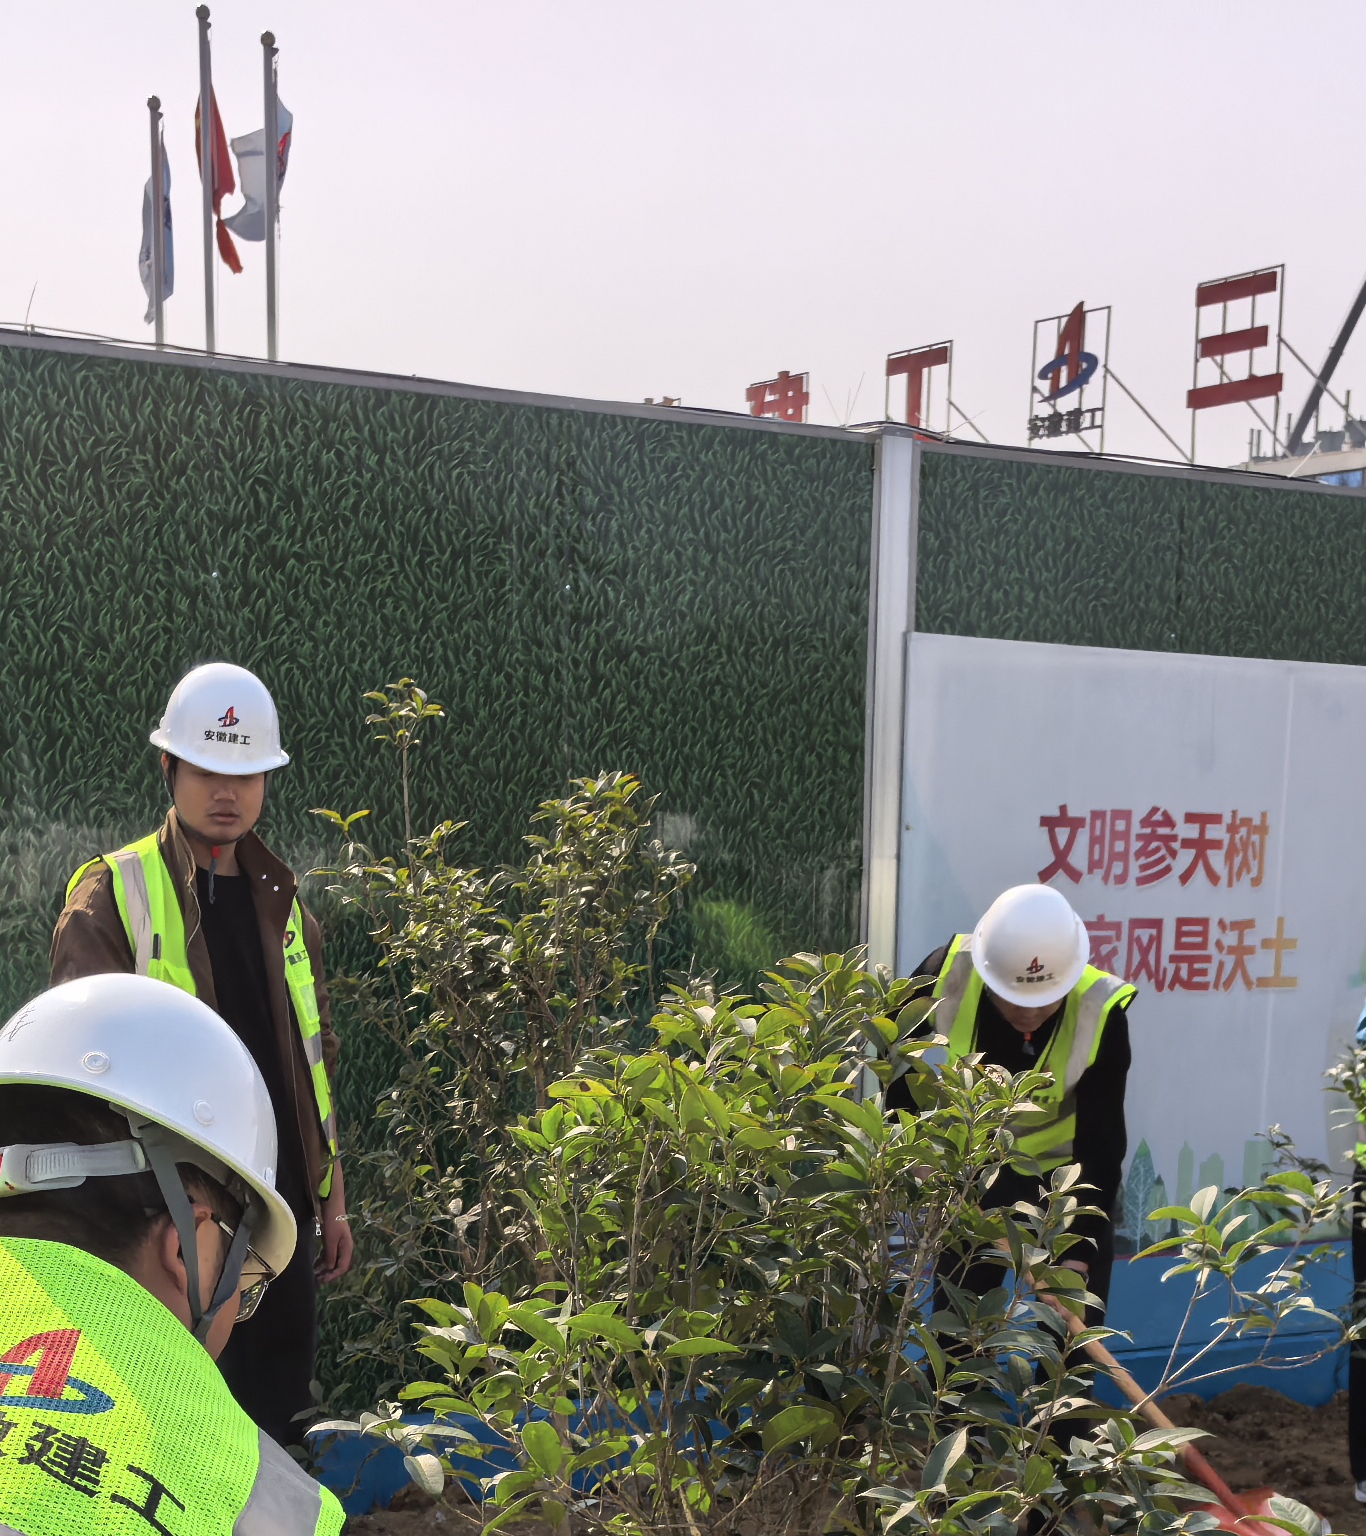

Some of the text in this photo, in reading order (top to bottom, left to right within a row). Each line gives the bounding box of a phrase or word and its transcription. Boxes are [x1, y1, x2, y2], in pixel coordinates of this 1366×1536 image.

[204, 729, 251, 746] 安徽建工
[1037, 803, 1269, 889] 文明参天树
